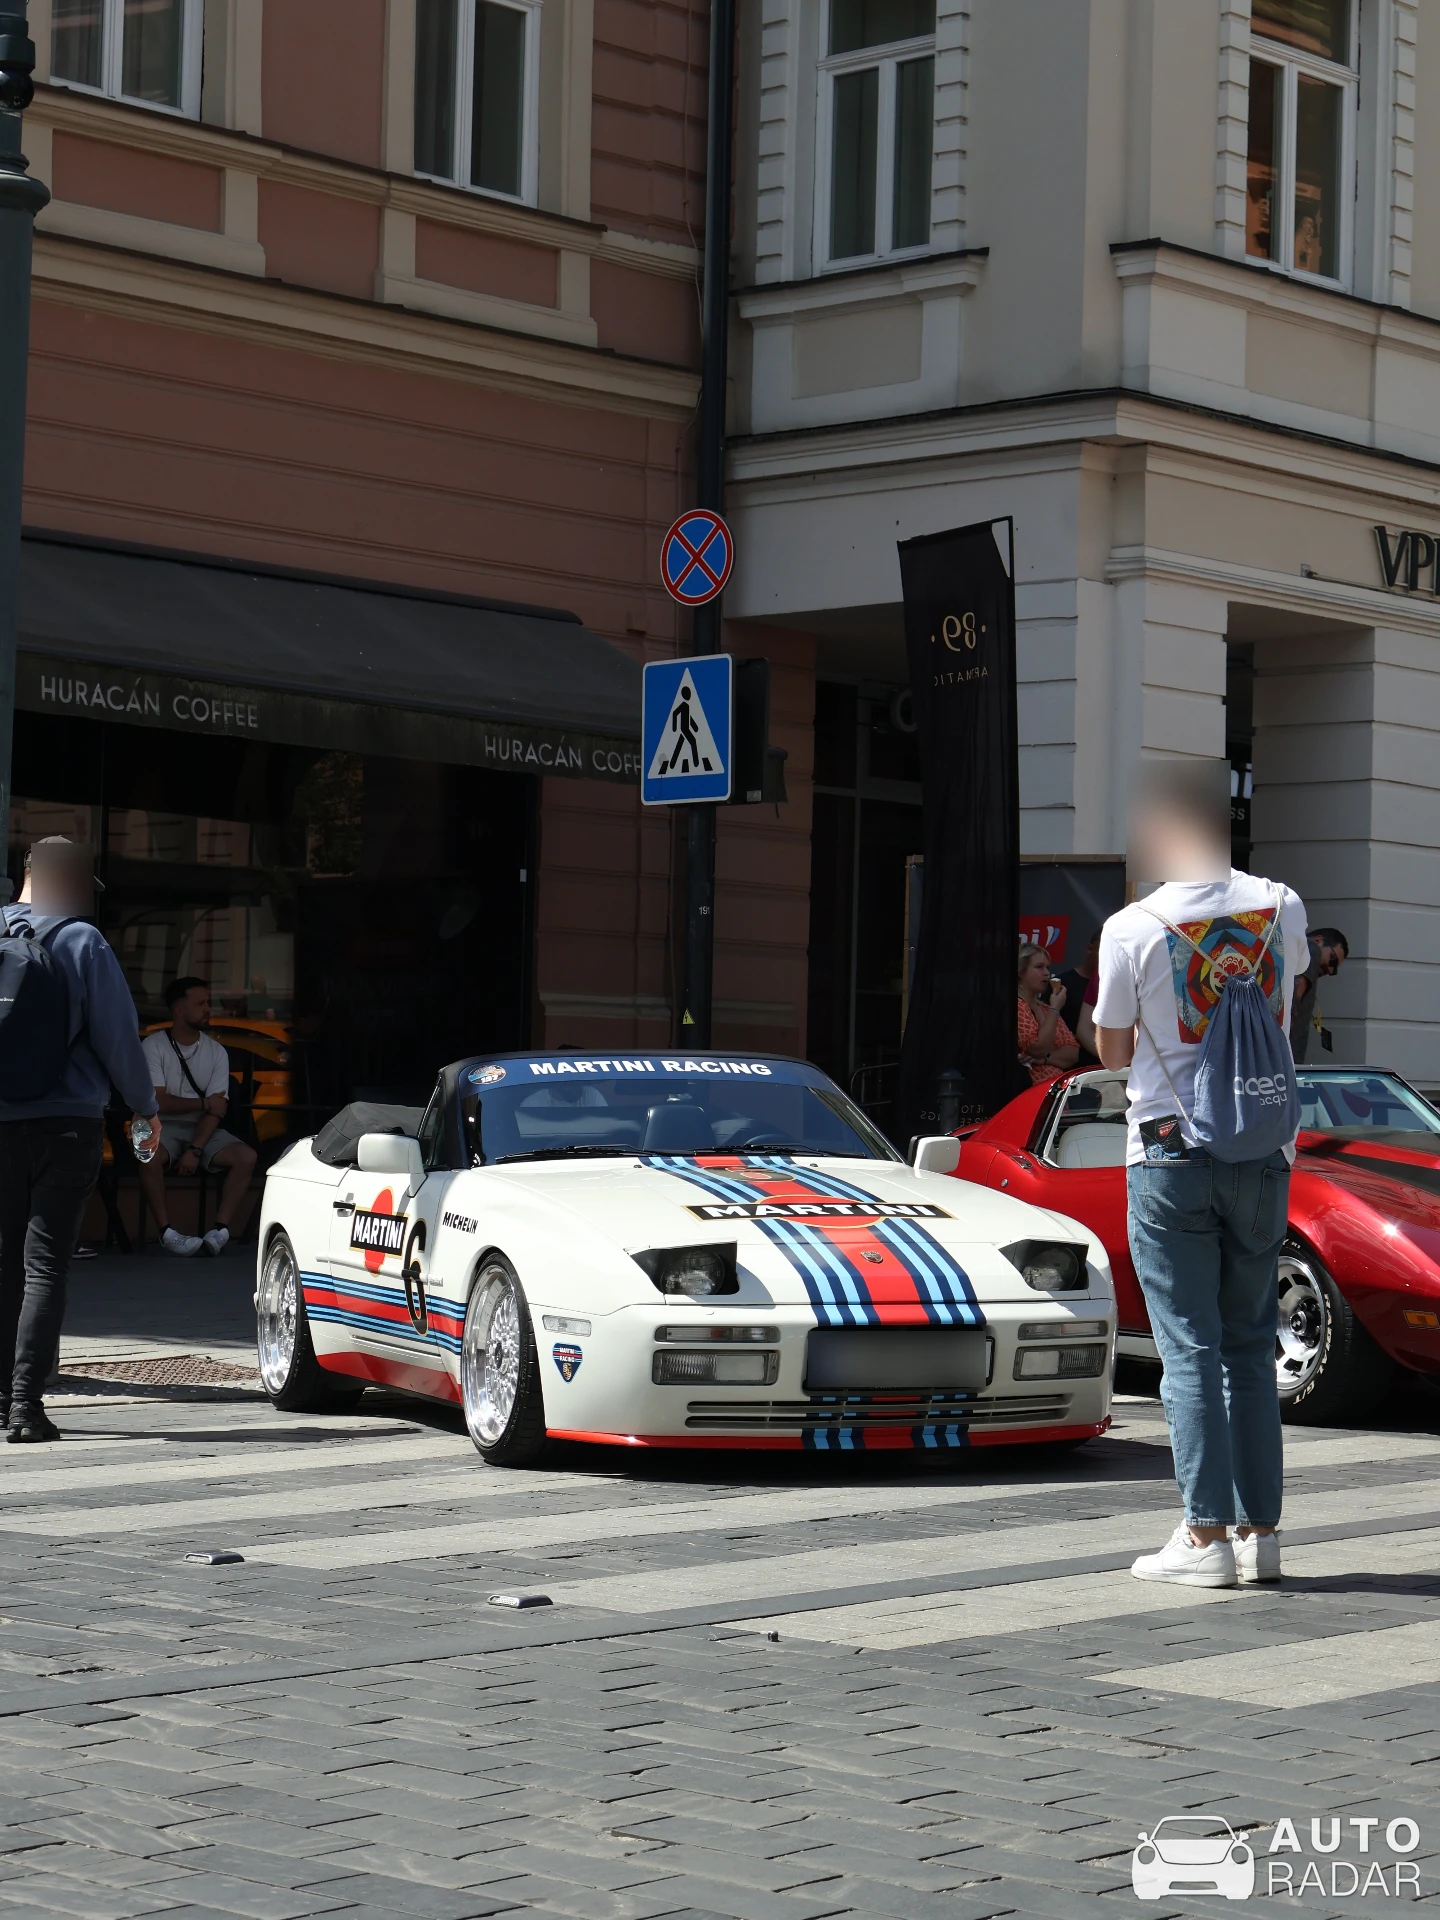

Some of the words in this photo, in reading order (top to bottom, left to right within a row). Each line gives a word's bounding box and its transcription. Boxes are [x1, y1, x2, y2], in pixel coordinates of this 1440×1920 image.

[41, 675, 160, 716] HURACÁN
[172, 694, 259, 728] COFFEE
[485, 735, 582, 769] HURACÁN
[528, 1060, 655, 1075] MARTINI
[664, 1060, 772, 1076] RACING
[442, 1211, 478, 1234] MICHELIN
[701, 1204, 937, 1218] MARTINI
[353, 1215, 405, 1249] MARTINI
[404, 1218, 428, 1336] 6
[1317, 1293, 1332, 1375] RADIAL
